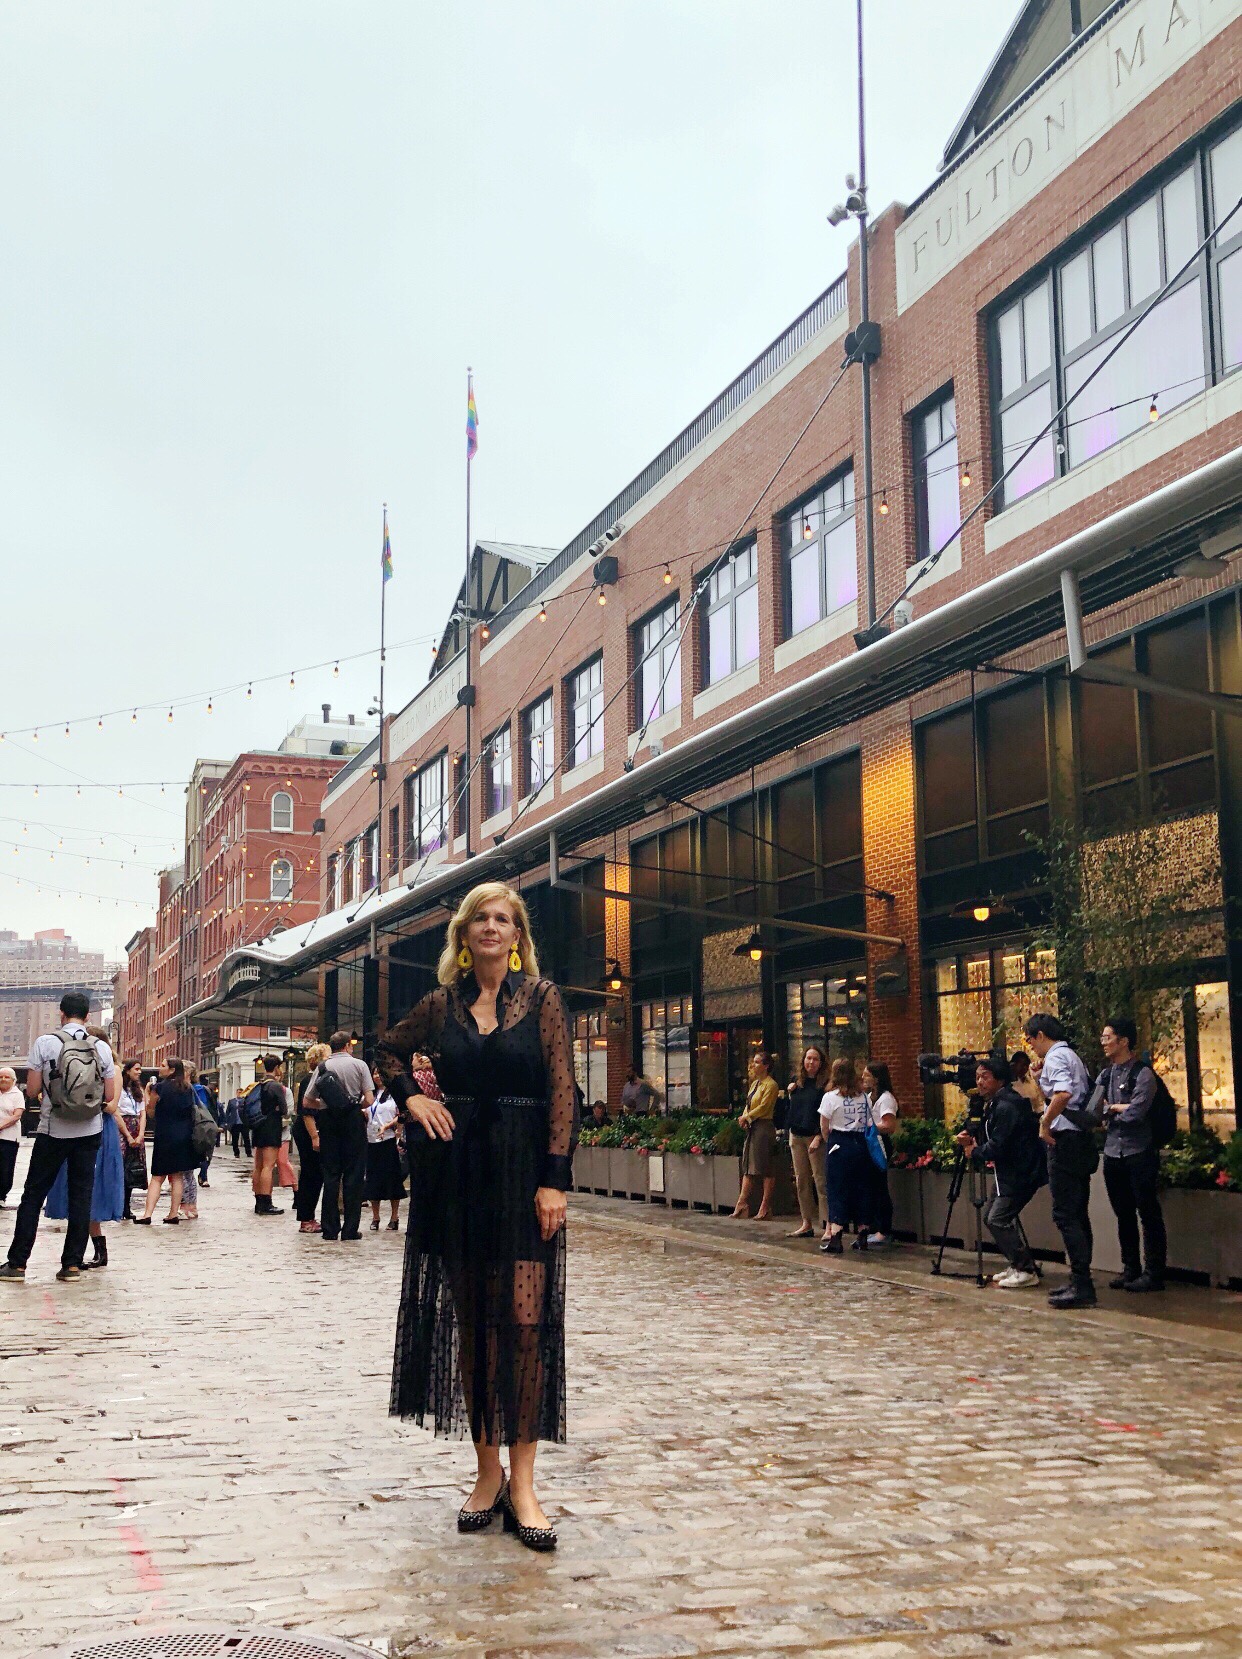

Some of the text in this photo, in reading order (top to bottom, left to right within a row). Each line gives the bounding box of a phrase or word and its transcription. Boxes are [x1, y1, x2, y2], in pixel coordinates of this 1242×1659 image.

[912, 0, 1213, 274] FULTON MA
[425, 670, 463, 717] MARKET
